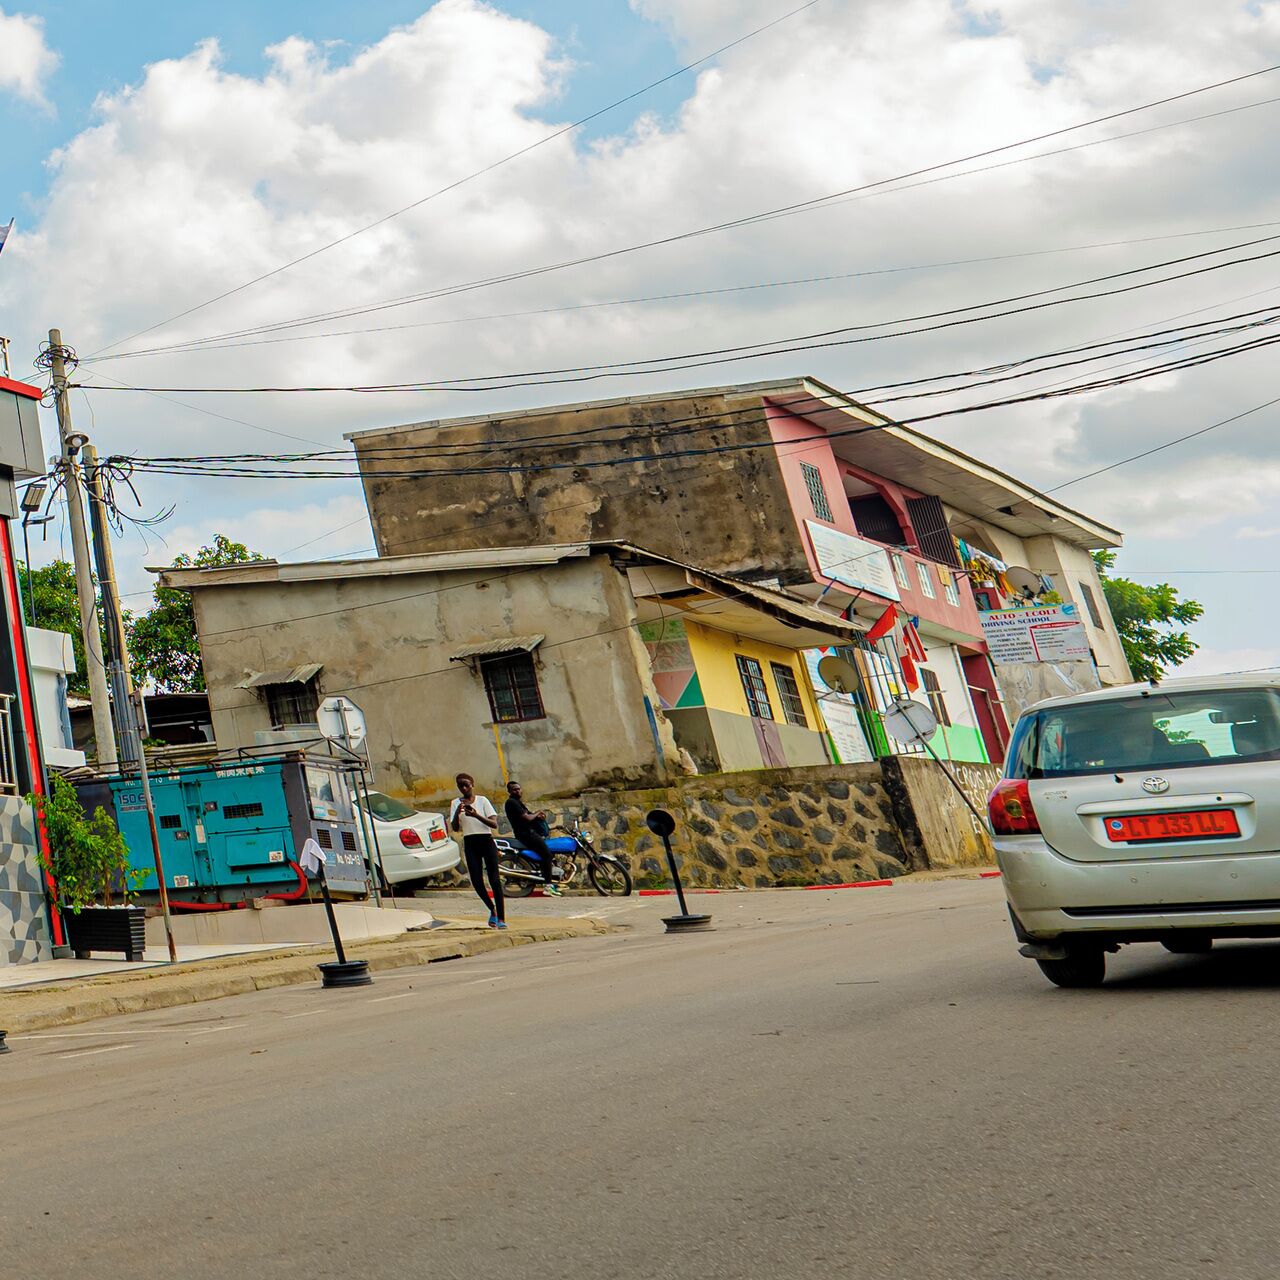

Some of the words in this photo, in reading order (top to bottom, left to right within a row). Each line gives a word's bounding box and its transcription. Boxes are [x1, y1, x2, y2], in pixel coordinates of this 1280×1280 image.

[989, 613, 1016, 621] AUTO
[1025, 608, 1059, 618] ECOLE
[981, 620, 1016, 628] DRIVING
[1018, 616, 1051, 625] SCHOOL
[1128, 818, 1151, 836] LT
[1157, 815, 1194, 835] 133
